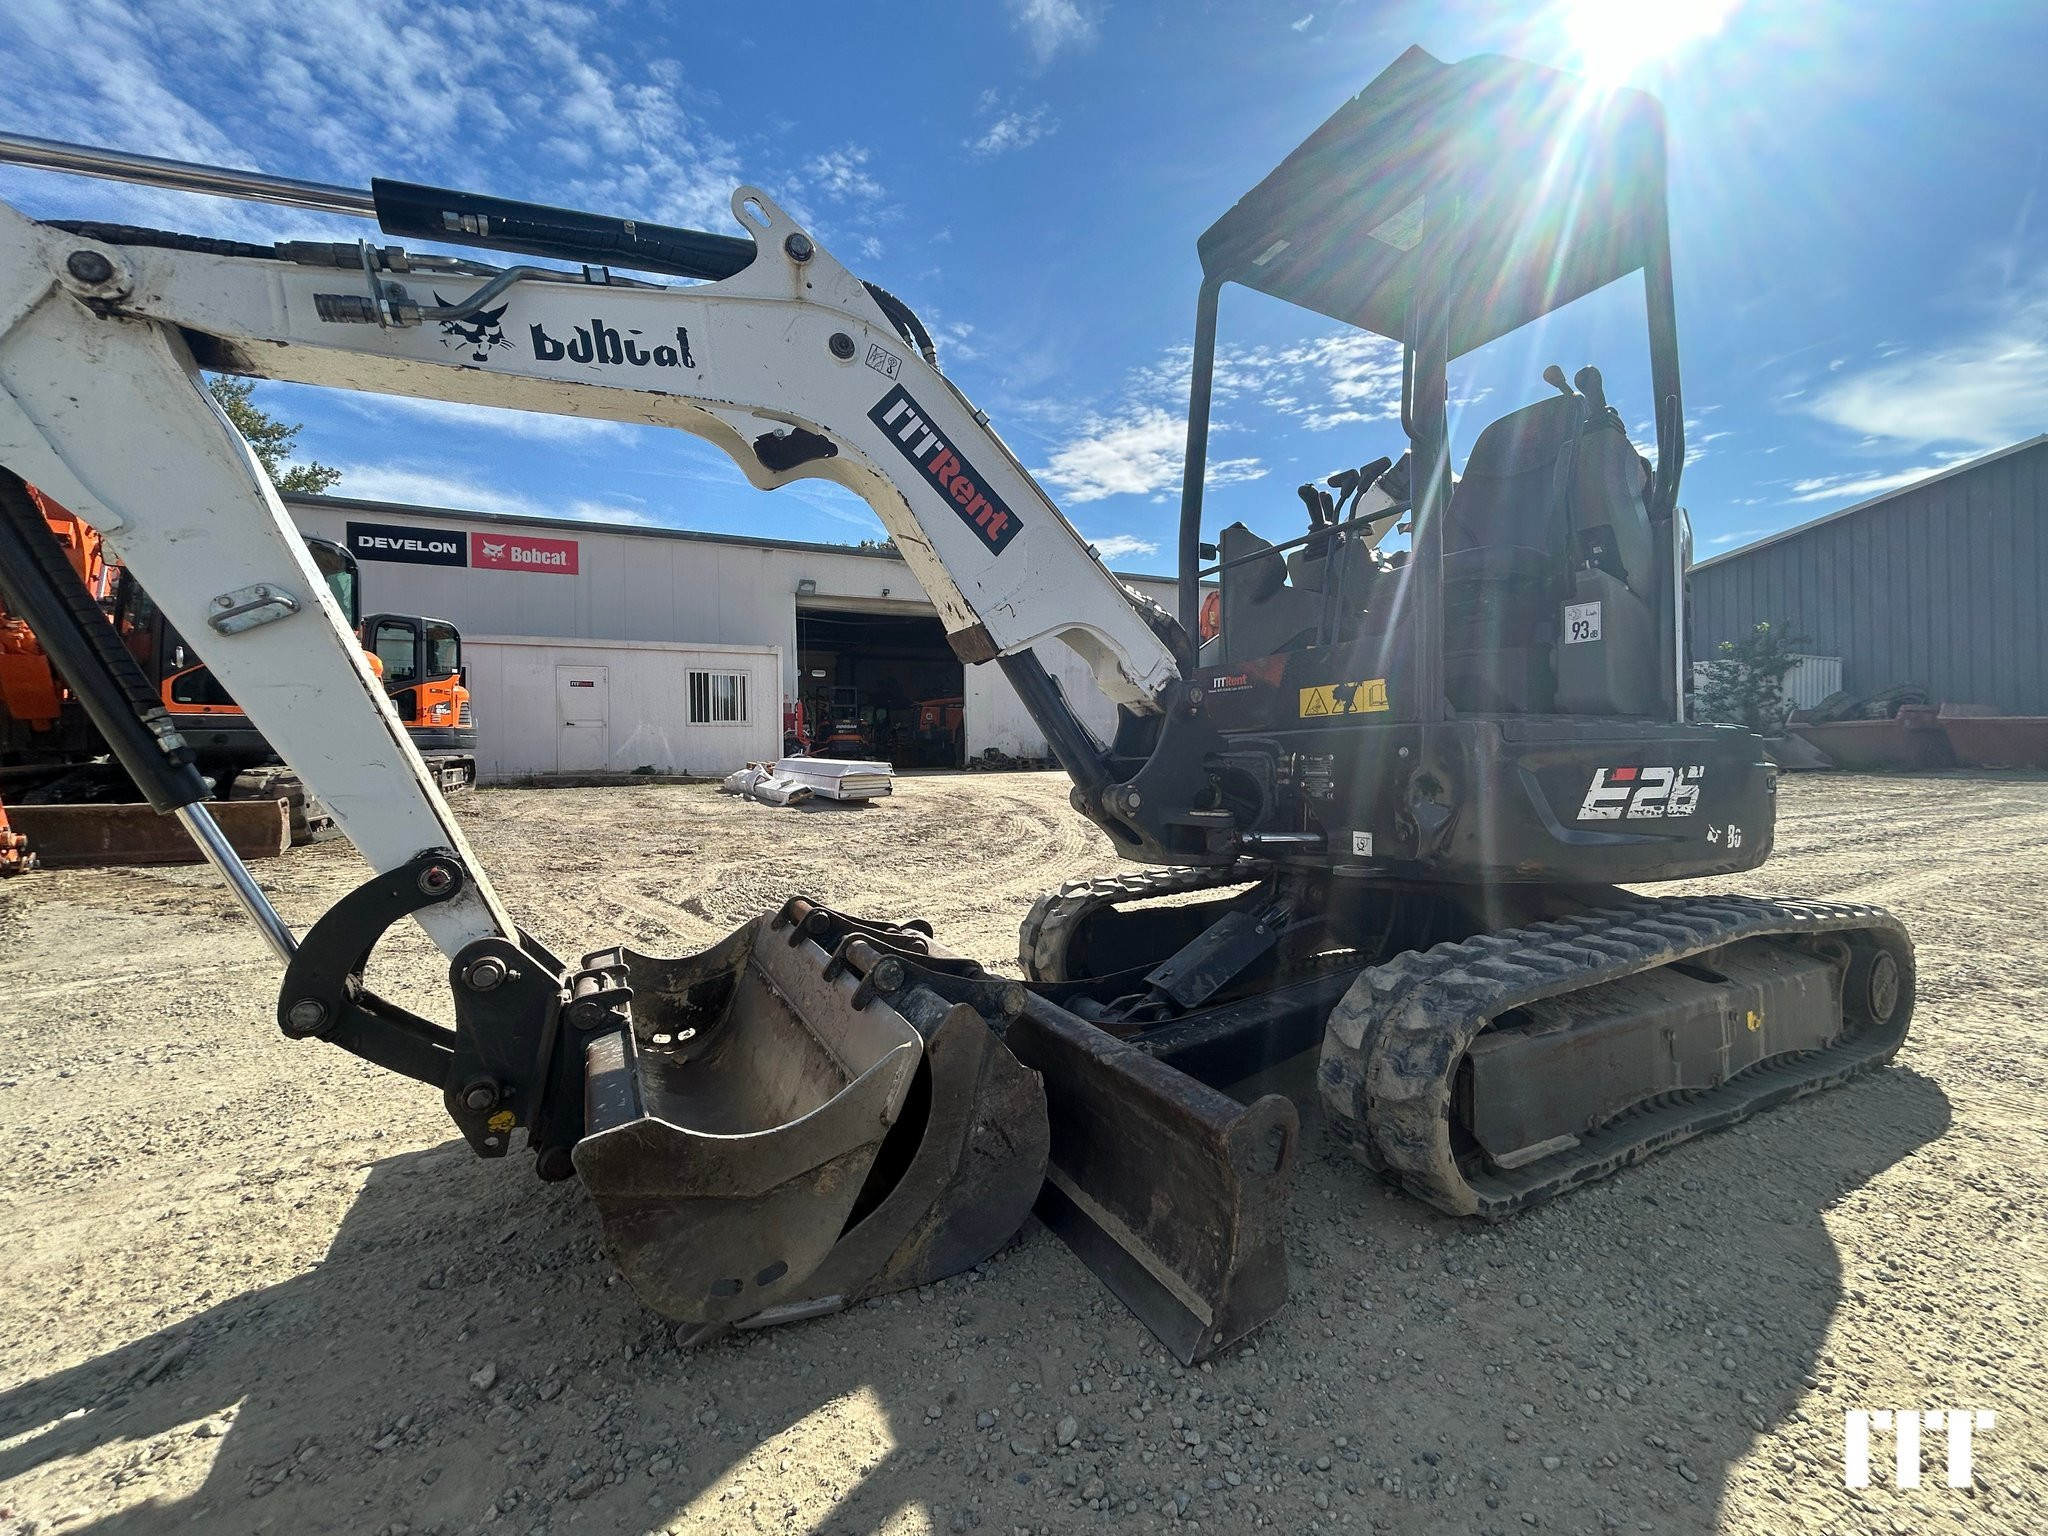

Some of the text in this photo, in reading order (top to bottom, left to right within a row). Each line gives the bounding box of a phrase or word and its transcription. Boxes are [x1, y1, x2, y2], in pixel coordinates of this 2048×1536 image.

[358, 535, 457, 554] DEVELON
[511, 546, 567, 566] Bobcat
[1572, 620, 1590, 640] 93
[1577, 766, 1705, 821] E26
